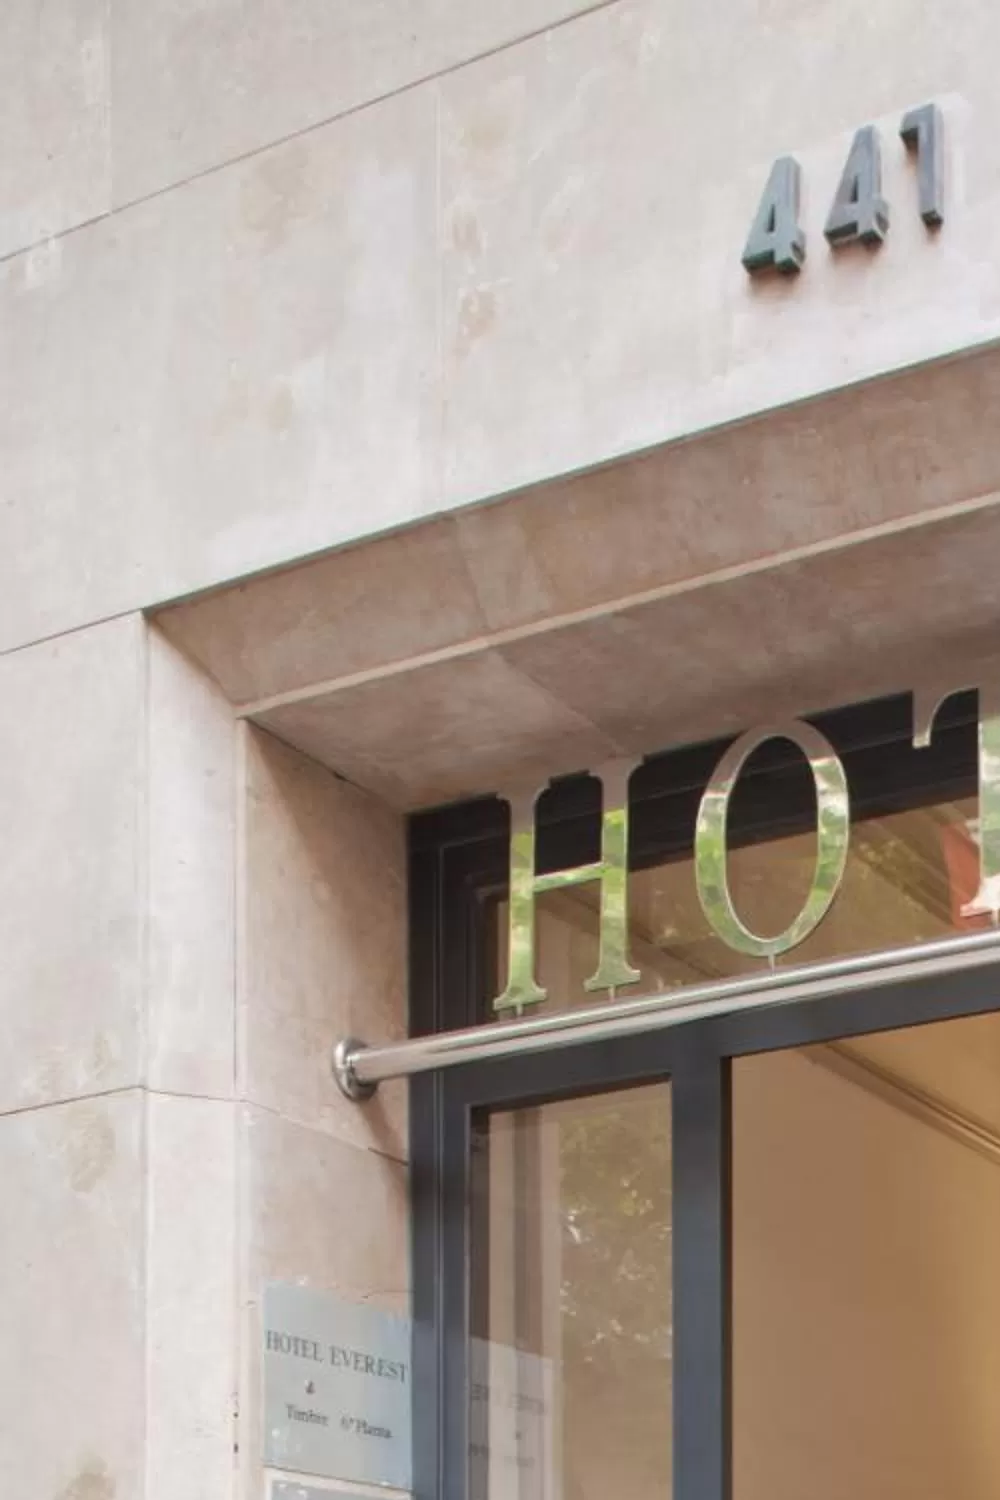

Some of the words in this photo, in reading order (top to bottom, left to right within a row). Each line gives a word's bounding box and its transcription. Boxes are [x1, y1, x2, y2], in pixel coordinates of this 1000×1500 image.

[741, 103, 944, 275] 441
[266, 1330, 324, 1363] HOTEL
[329, 1345, 407, 1383] EVEREST
